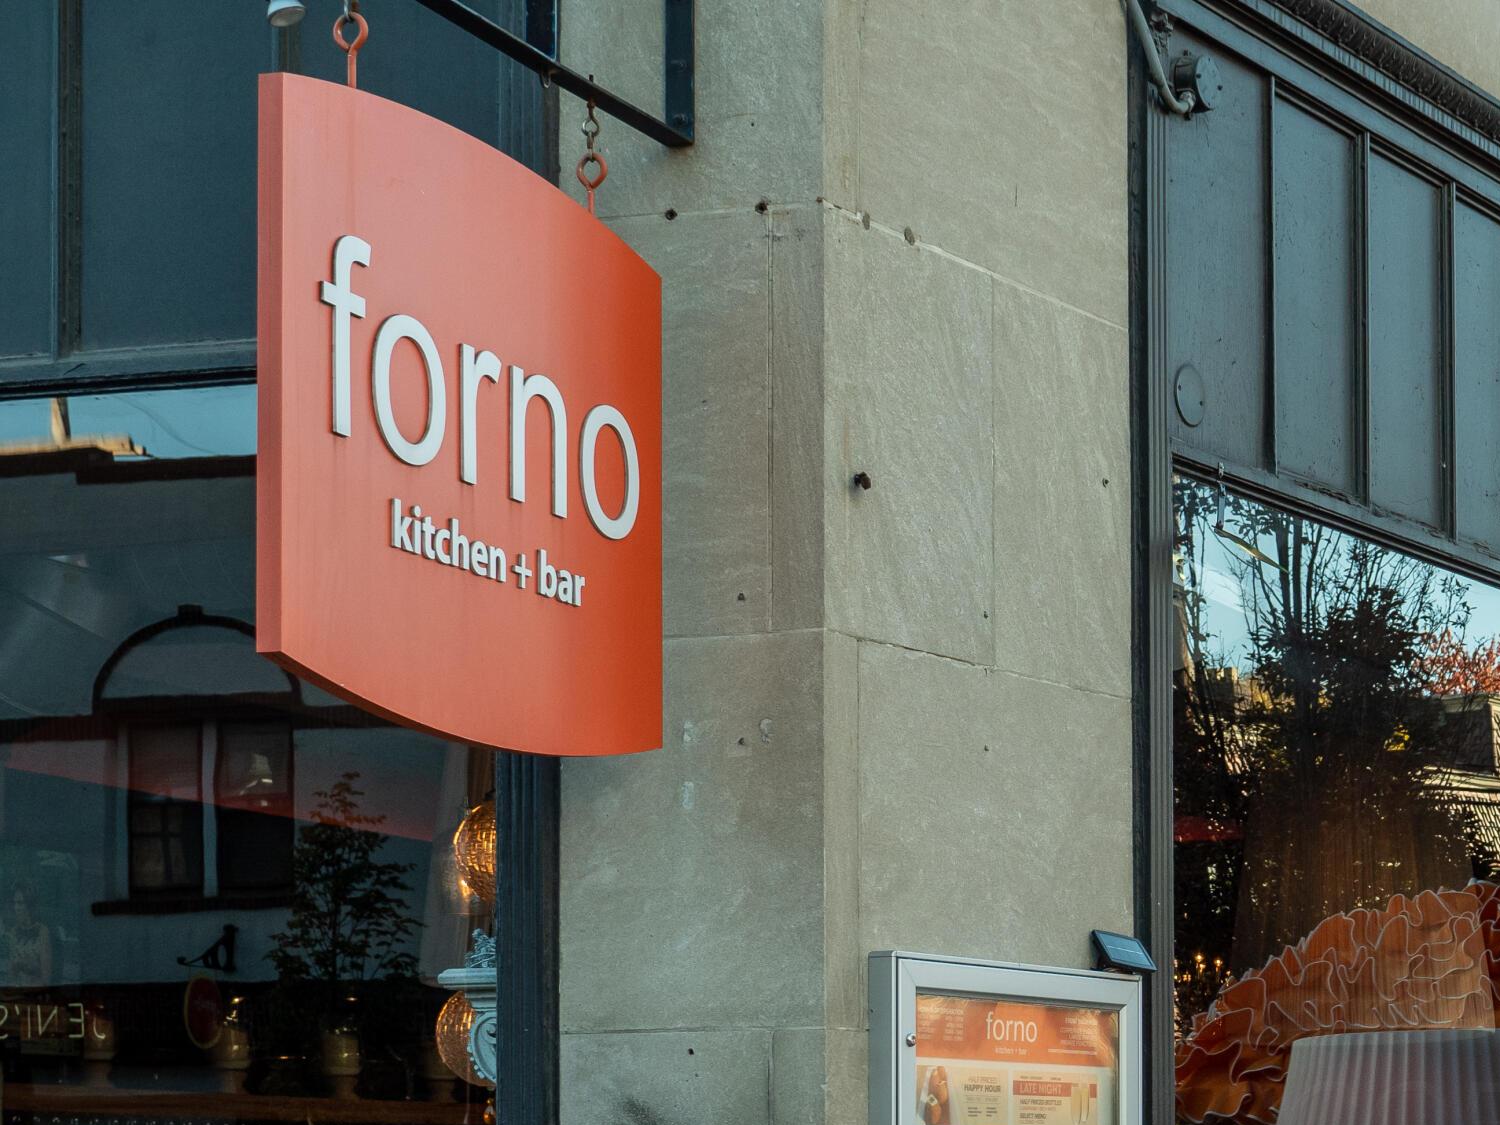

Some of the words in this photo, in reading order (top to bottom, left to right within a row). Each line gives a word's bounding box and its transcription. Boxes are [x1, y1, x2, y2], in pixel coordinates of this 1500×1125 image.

[319, 234, 640, 541] forno
[390, 497, 507, 583] kitchen
[537, 548, 586, 608] bar
[986, 1011, 1038, 1043] forno
[964, 1084, 983, 1092] HAPPY
[1020, 1081, 1038, 1094] LATE
[1039, 1083, 1062, 1096] NIGHT
